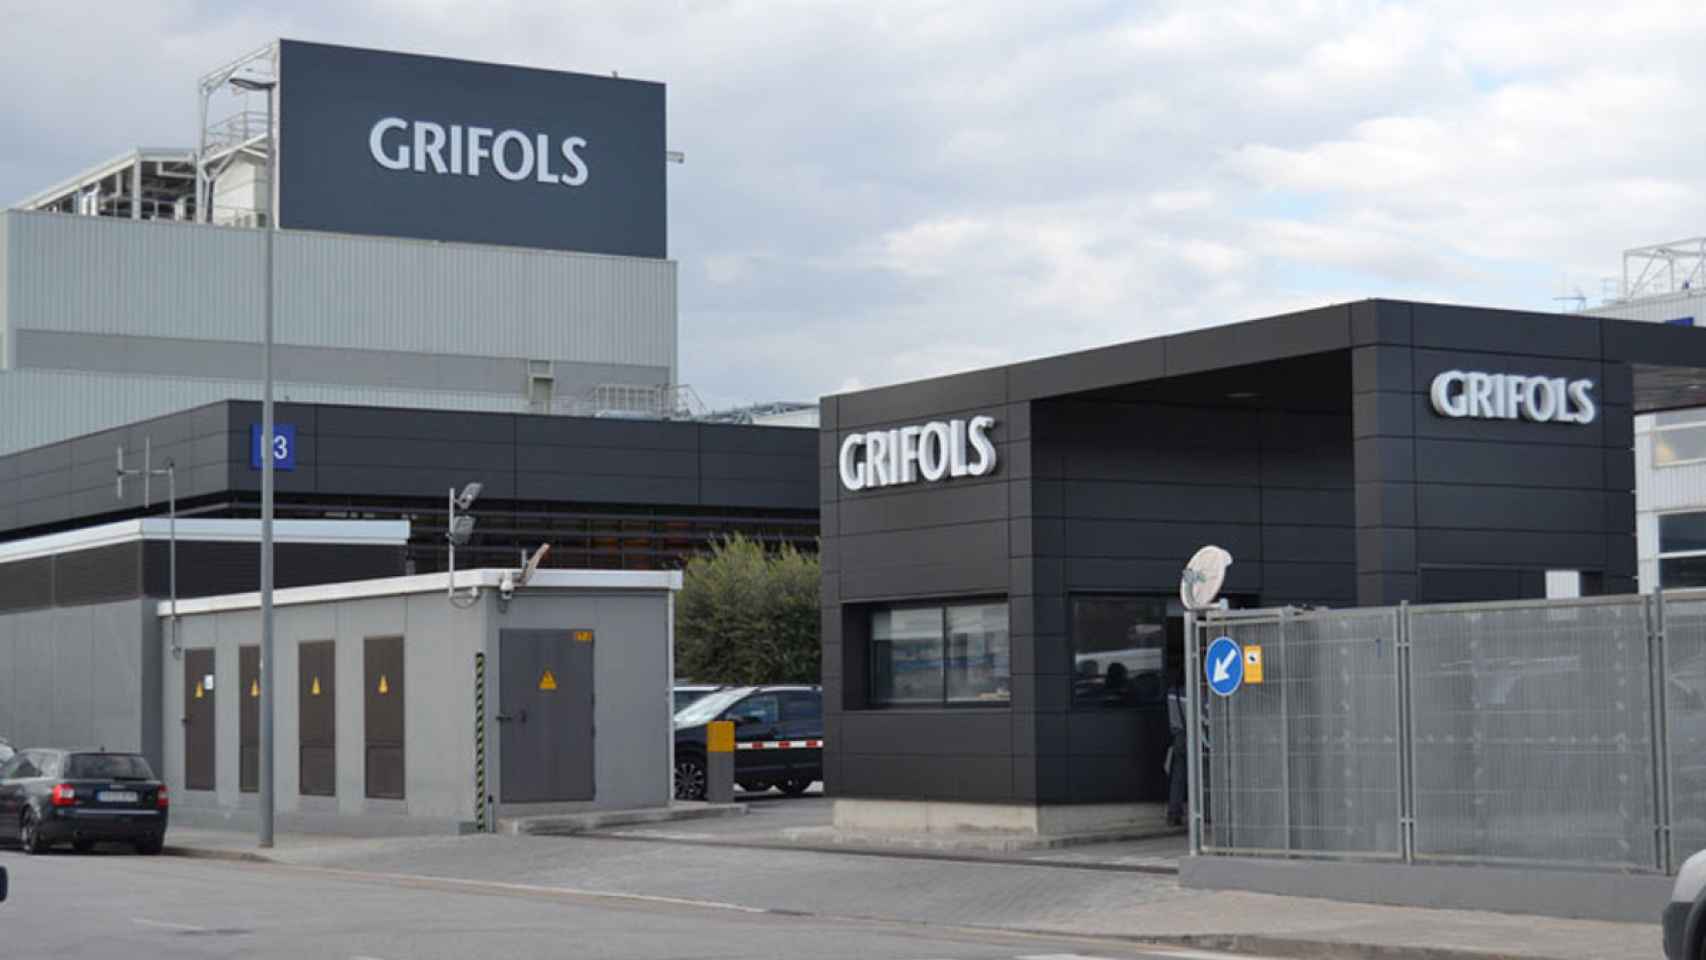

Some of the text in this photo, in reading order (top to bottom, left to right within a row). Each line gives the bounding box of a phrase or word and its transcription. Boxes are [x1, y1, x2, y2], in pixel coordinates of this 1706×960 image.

[369, 117, 588, 186] GRIFOLS
[1430, 370, 1595, 424] GRIFOLS
[839, 415, 996, 490] GRIFOLS
